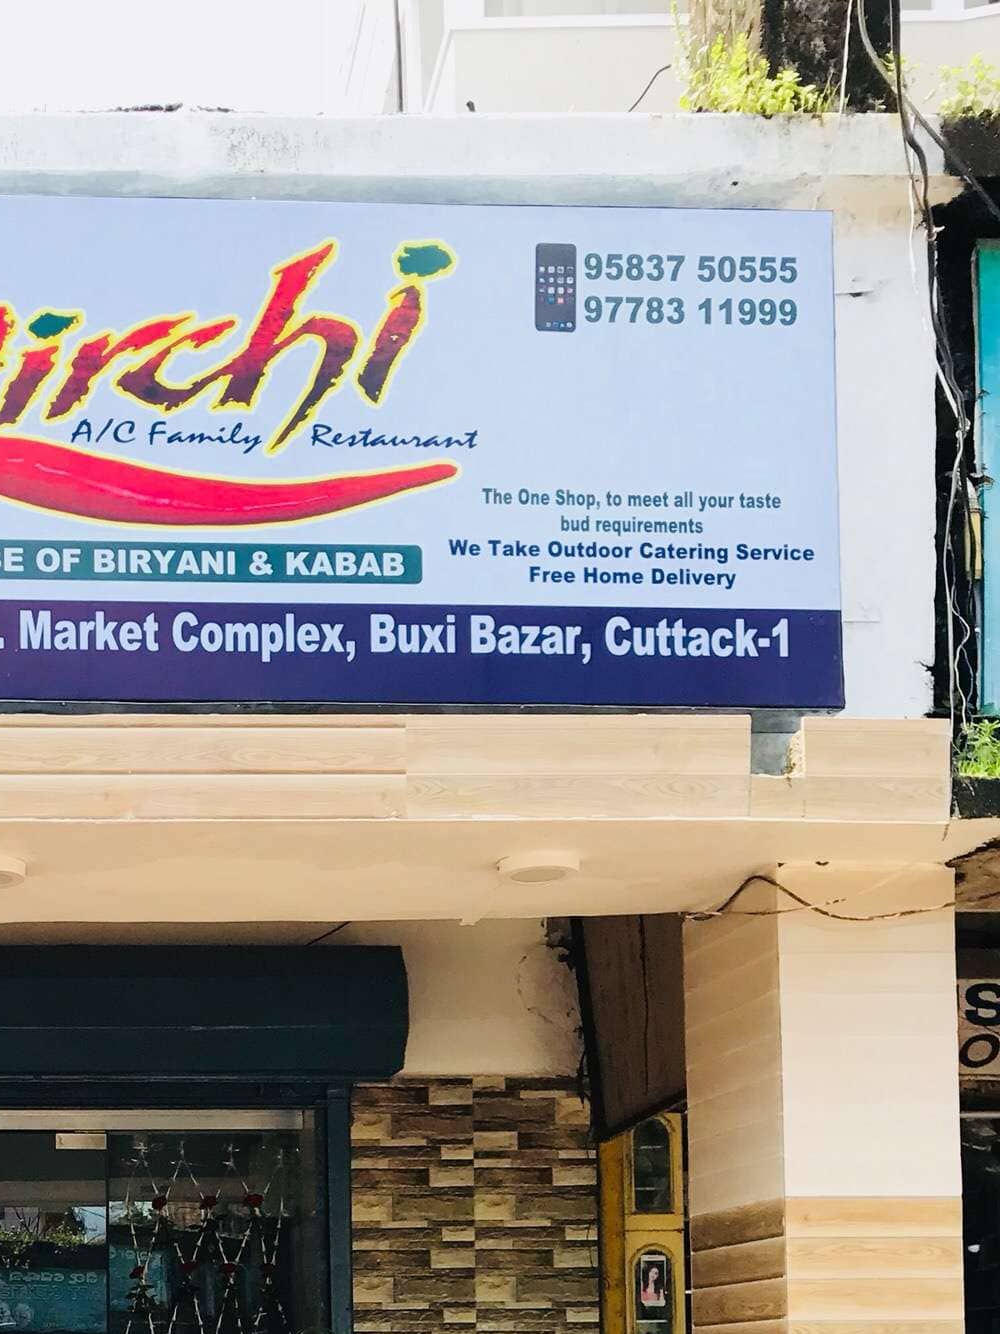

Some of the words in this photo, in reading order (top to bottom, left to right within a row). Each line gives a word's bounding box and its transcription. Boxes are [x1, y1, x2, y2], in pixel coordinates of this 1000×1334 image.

[584, 252, 686, 282] 95837
[697, 255, 798, 284] 50555
[584, 295, 685, 325] 97783
[698, 297, 798, 326] 11999
[71, 419, 136, 444] A/C
[148, 420, 263, 455] Family
[310, 423, 478, 449] Restaurant
[481, 487, 513, 505] The
[518, 488, 550, 506] One
[555, 488, 601, 511] Shop,
[605, 490, 622, 507] to
[627, 491, 669, 508] meet
[673, 491, 694, 508] all
[698, 495, 735, 513] your
[739, 492, 782, 509] taste
[560, 515, 590, 532] bud
[595, 516, 704, 537] requirements
[35, 547, 82, 573] OF
[93, 549, 236, 576] BIRYANI
[249, 550, 275, 576] &
[286, 551, 406, 577] KABAB
[448, 538, 481, 557] We
[487, 539, 541, 557] Take
[547, 540, 633, 559] Outdoor
[639, 542, 729, 565] Catering
[735, 543, 815, 561] Service
[529, 566, 576, 584] Free
[583, 566, 644, 585] Home
[651, 567, 738, 590] Delivery
[19, 610, 159, 652] Market
[171, 612, 357, 663] Complex,
[369, 613, 457, 653] Buxi
[469, 615, 592, 665] Bazar,
[604, 616, 791, 658] Cuttack-1
